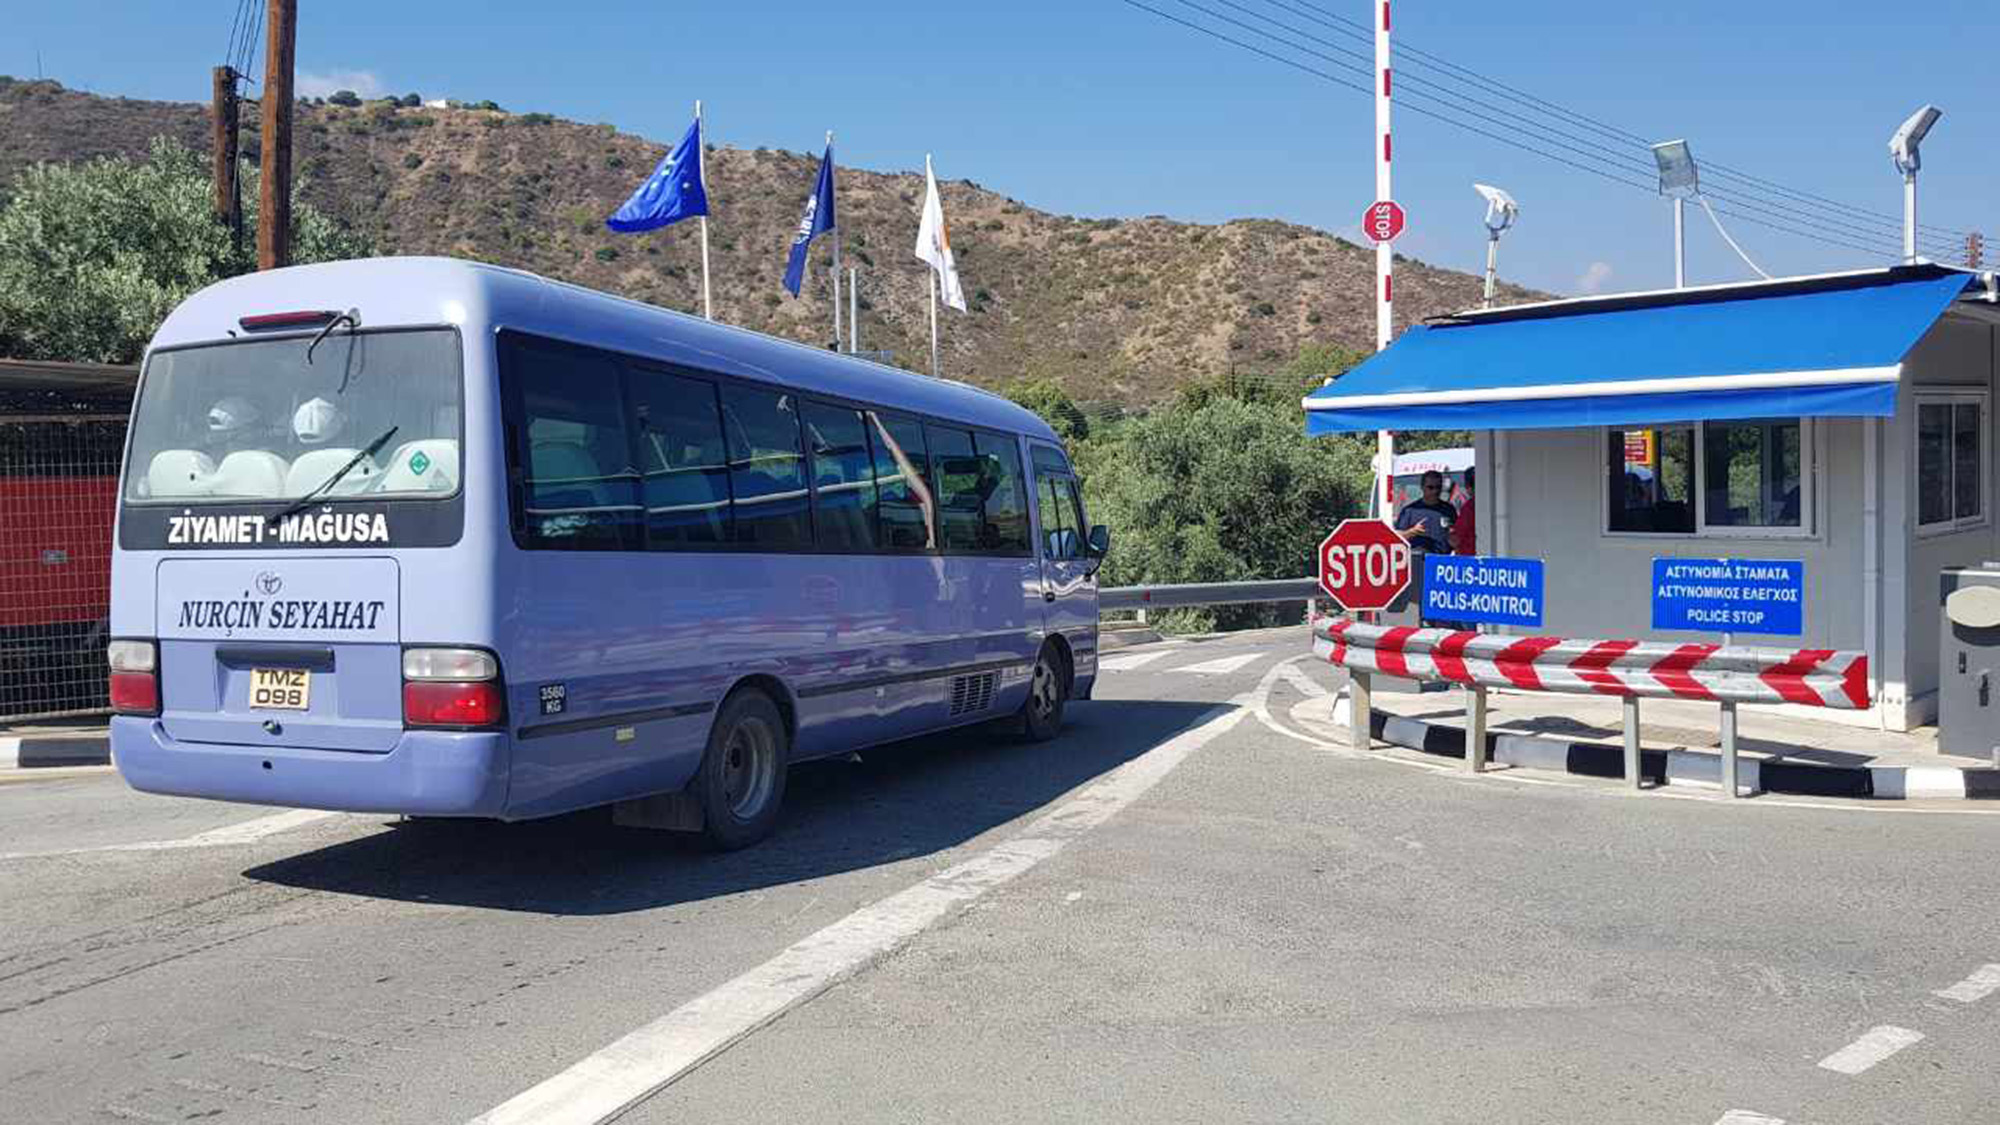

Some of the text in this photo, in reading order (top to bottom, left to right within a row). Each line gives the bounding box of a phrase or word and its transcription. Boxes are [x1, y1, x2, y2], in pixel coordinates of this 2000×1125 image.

[1375, 205, 1391, 239] STOP
[168, 509, 265, 543] ZİYAMET
[1327, 543, 1407, 589] STOP
[1735, 566, 1790, 581] ΣΤΑΜΑΤΑ
[1658, 584, 1799, 603] ΑΣΤΥΝΟΜΙΚΟΣ ΕΛΕΓΧΟΣ
[178, 590, 385, 637] NURÇİN SEYAHAT
[1687, 608, 1764, 625] POLICE STOP
[256, 669, 305, 687] TMZ
[256, 688, 302, 705] 098
[546, 700, 562, 713] KG
